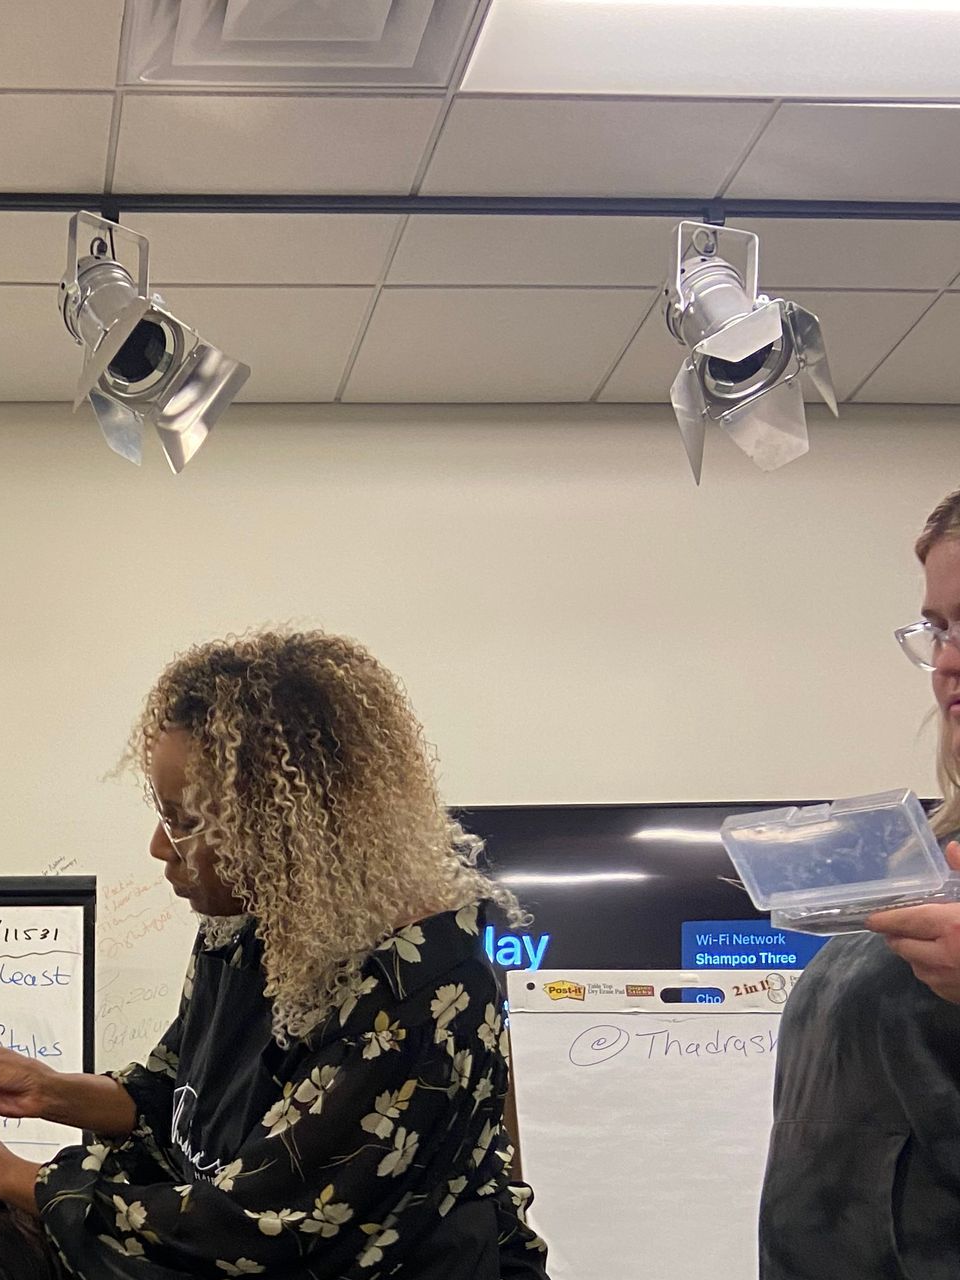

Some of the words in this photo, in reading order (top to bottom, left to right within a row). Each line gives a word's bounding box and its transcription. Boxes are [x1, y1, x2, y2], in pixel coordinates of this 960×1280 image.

[696, 933, 730, 946] Wi-Fi
[733, 933, 786, 945] Network
[485, 926, 549, 971] lay
[695, 953, 757, 966] Shampoo
[759, 952, 797, 964] Three
[0, 963, 72, 986] least
[548, 985, 583, 994] Post-it
[732, 985, 743, 997] 2
[743, 983, 759, 995] in
[696, 993, 721, 1004] Cho
